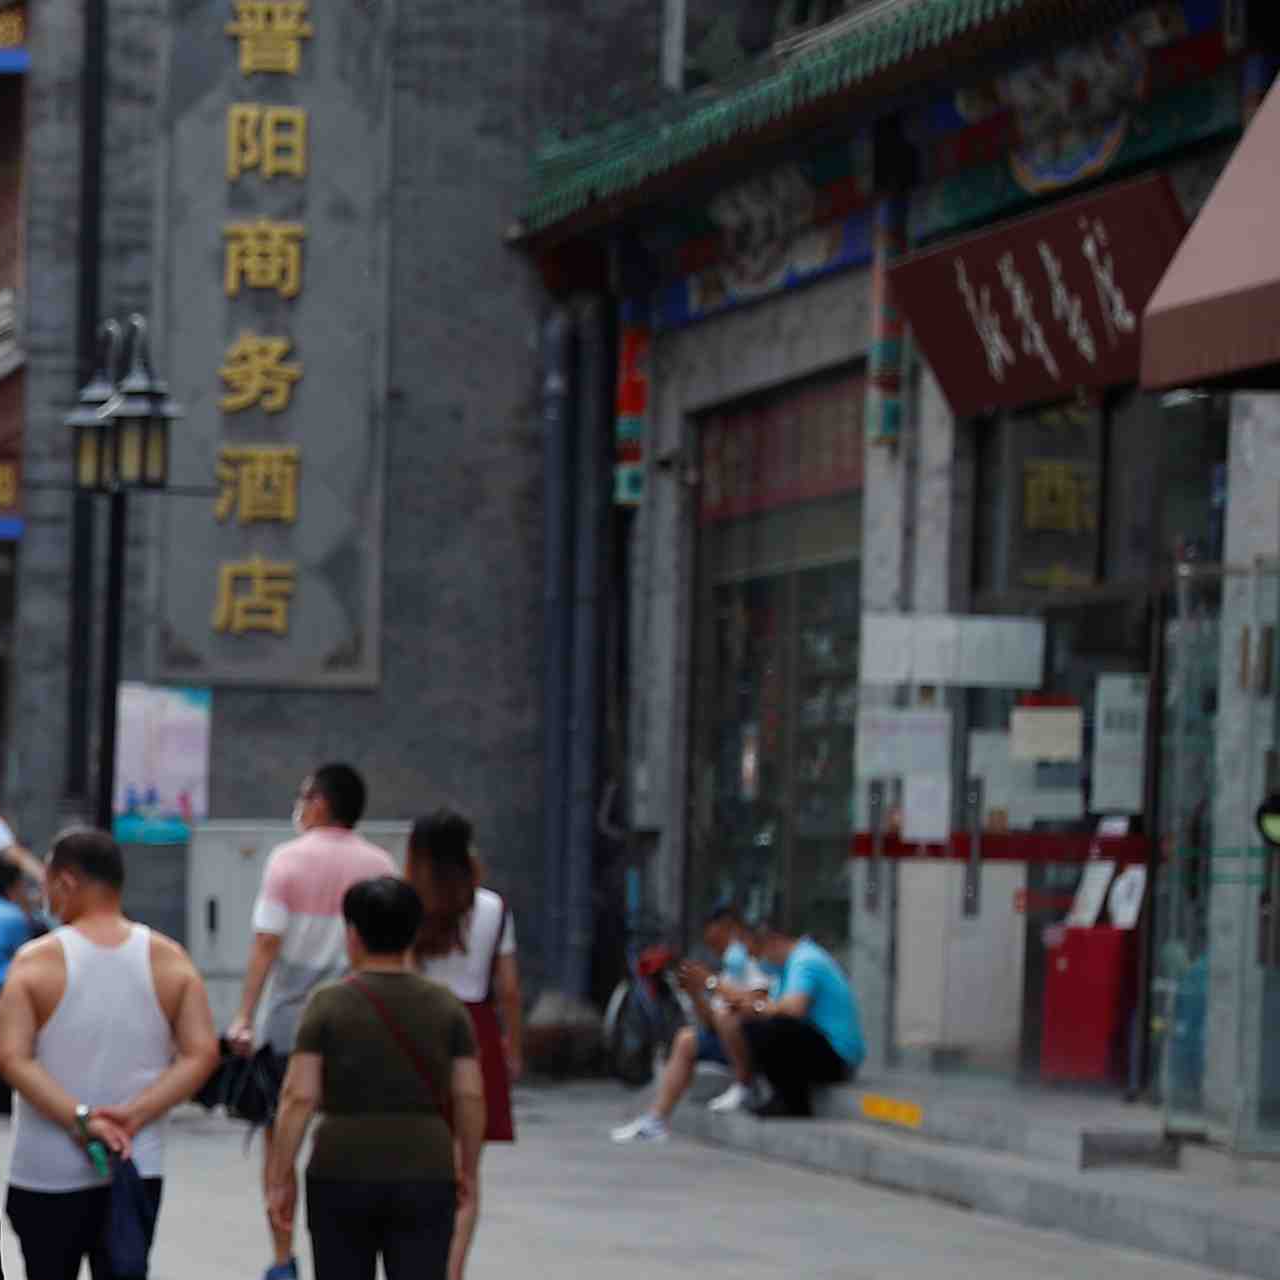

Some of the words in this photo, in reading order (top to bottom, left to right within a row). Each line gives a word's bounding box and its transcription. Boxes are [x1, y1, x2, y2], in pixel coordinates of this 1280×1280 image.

[214, 0, 313, 637] 晋阳商务酒店
